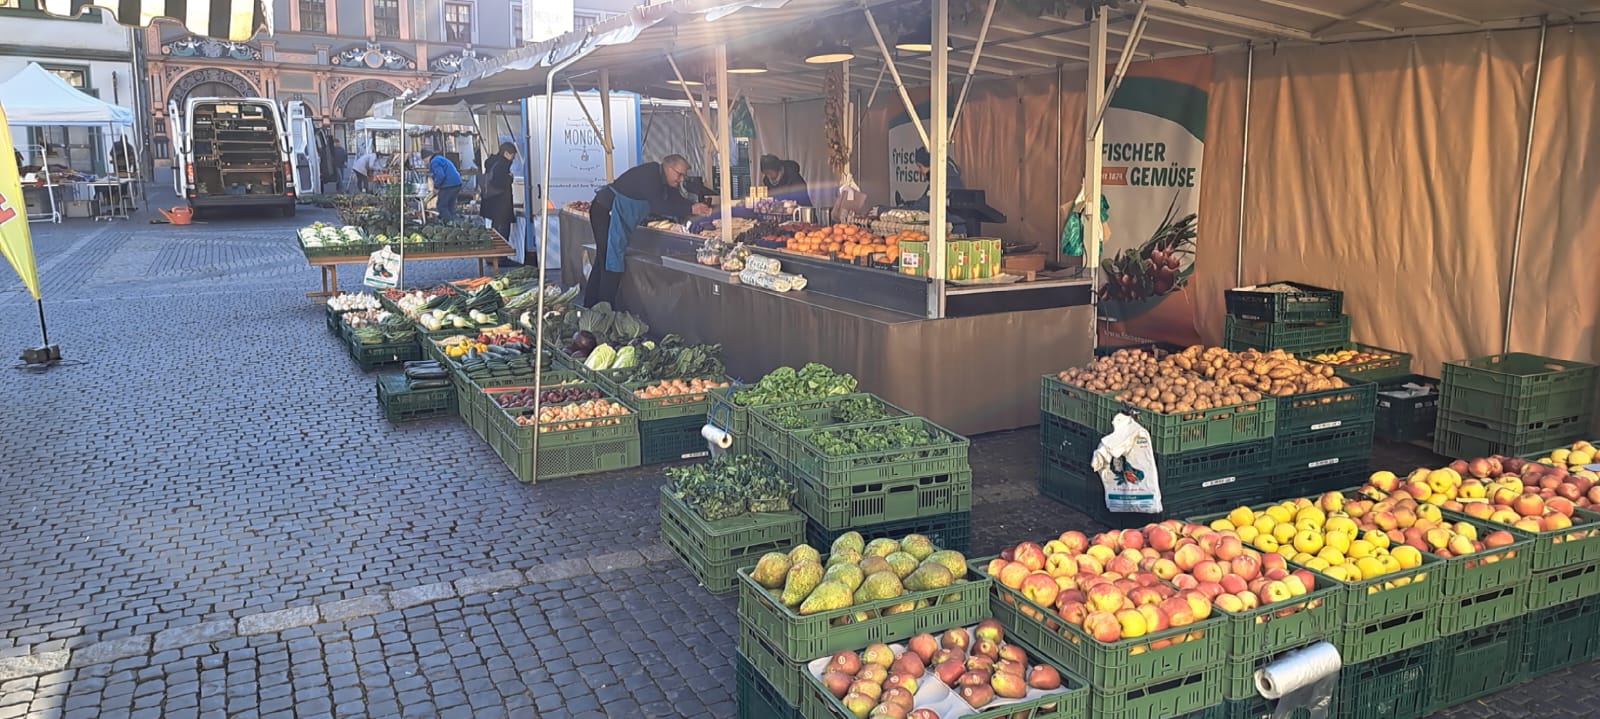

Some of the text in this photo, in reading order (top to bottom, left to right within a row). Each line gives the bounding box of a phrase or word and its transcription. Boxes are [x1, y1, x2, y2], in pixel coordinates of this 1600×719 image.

[892, 147, 917, 164] frisc
[1102, 143, 1166, 161] FISCHER
[1130, 162, 1196, 187] GEMÜSE
